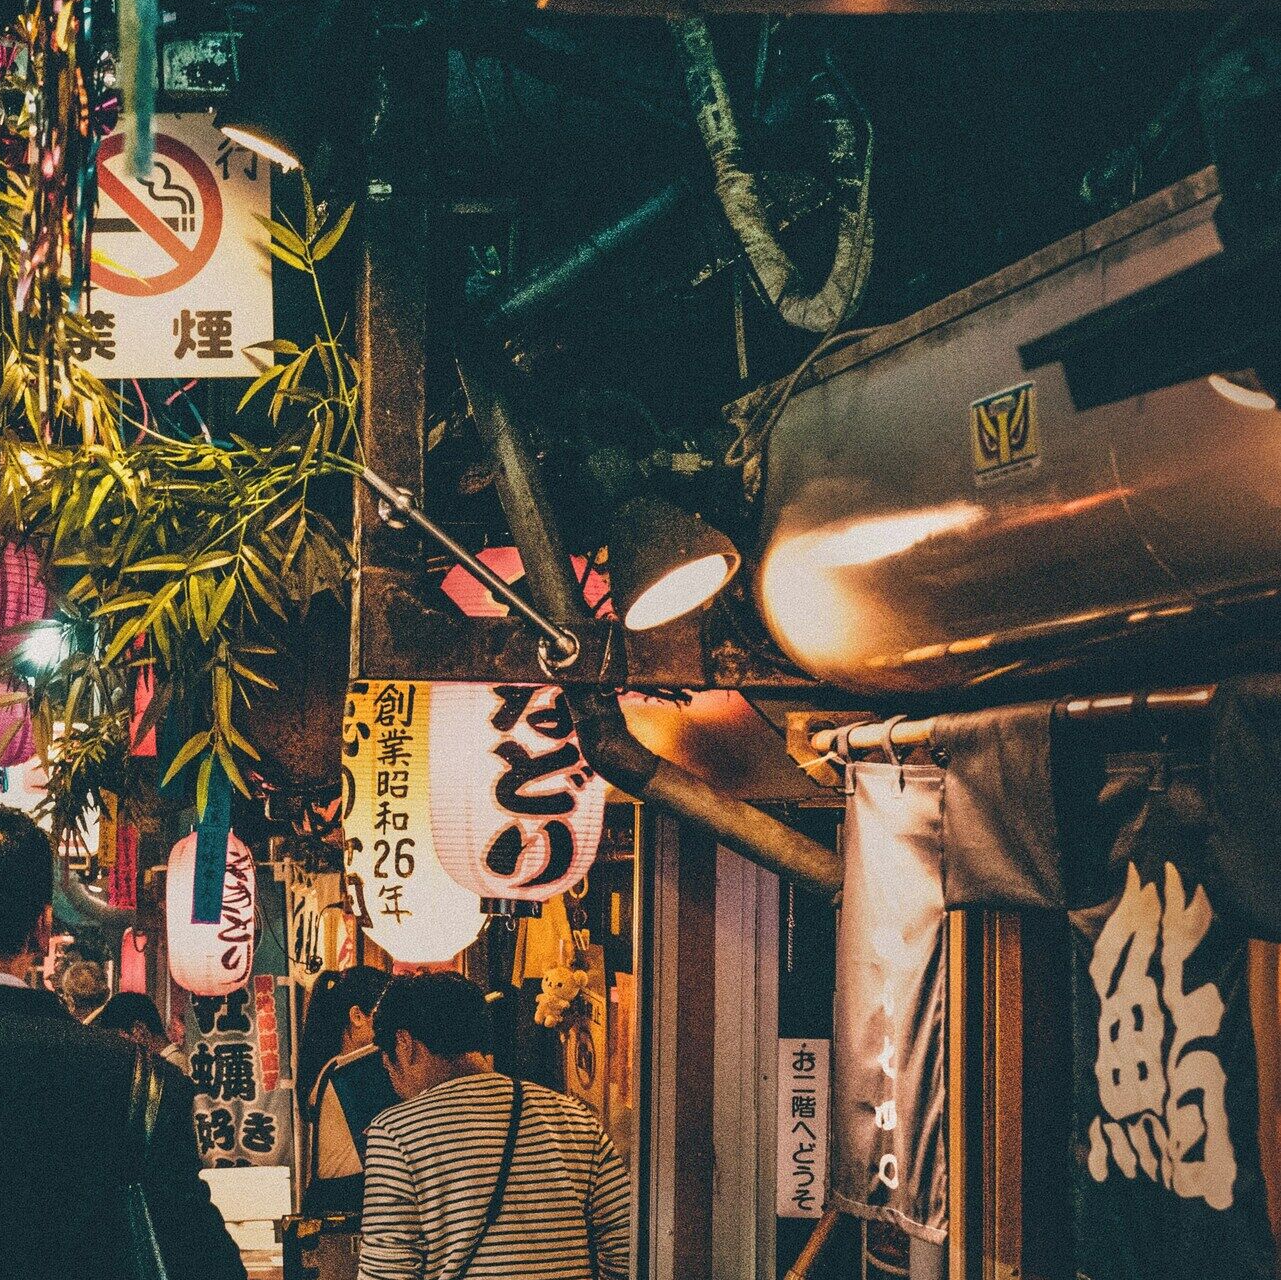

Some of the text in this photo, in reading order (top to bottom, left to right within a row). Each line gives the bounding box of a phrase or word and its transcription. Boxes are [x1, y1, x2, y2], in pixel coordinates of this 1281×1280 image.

[372, 682, 417, 924] 創業昭和26年
